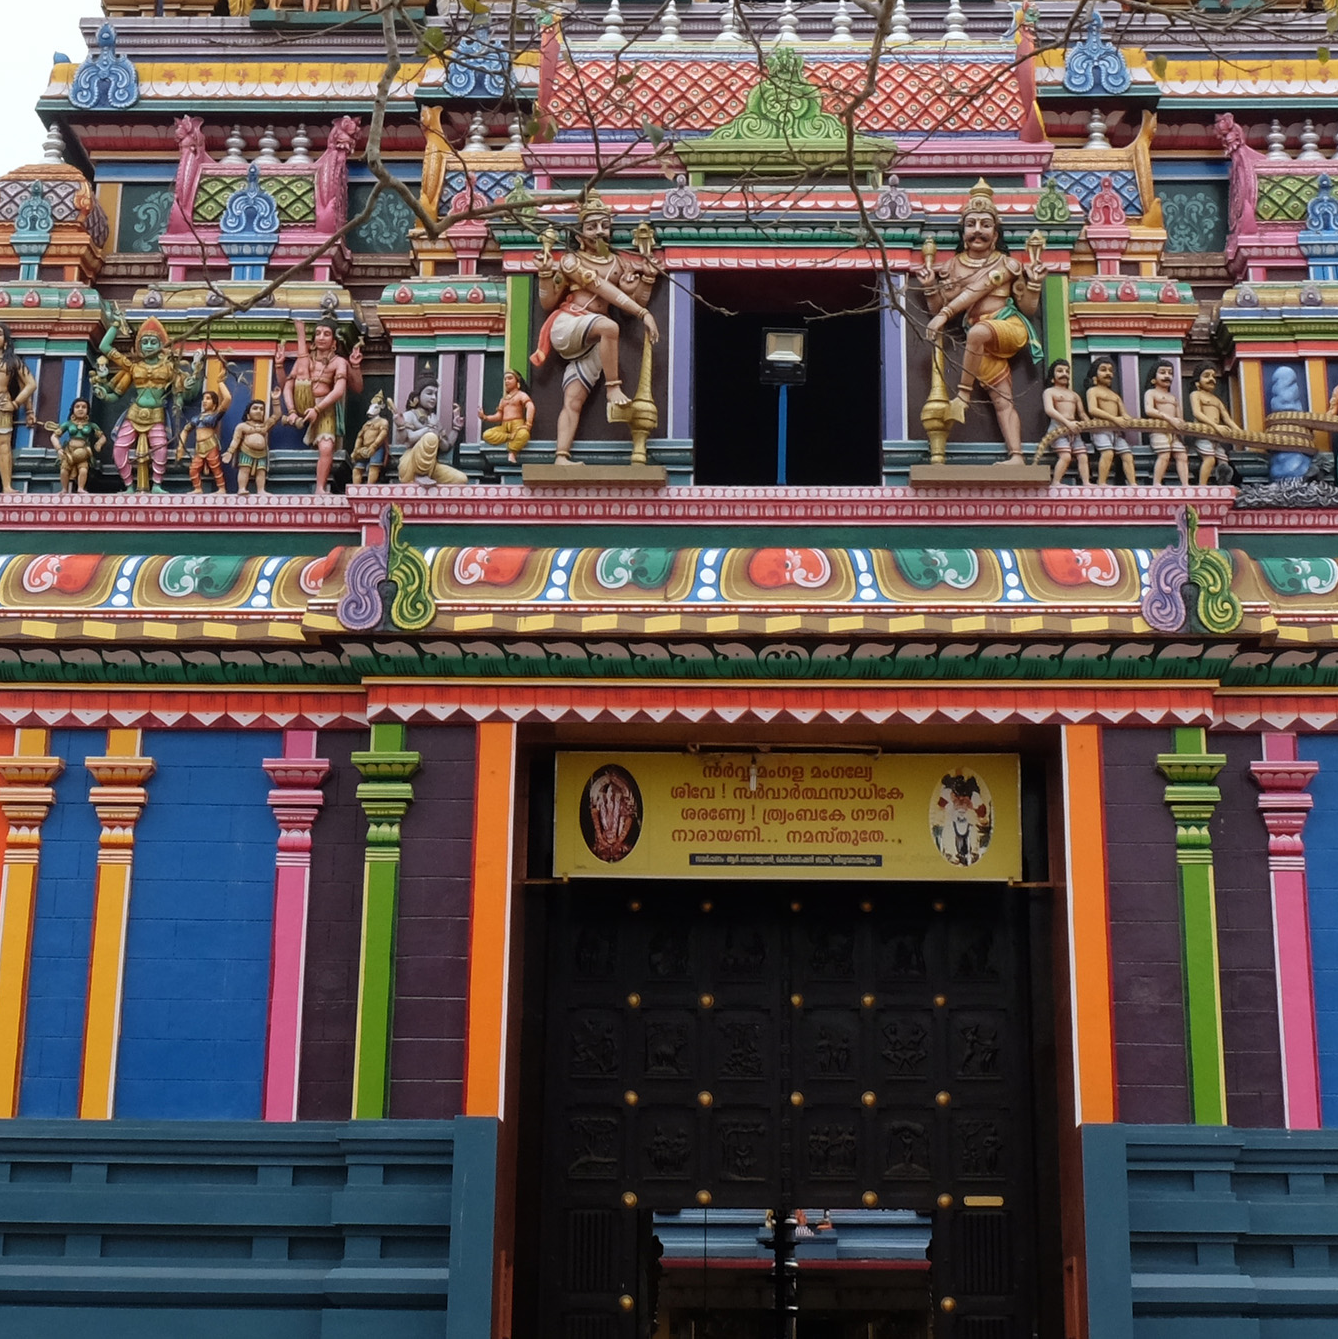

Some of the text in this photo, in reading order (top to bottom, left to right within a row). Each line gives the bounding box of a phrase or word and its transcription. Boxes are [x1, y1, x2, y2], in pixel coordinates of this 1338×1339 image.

[756, 765, 805, 782] മംഗള
[811, 765, 873, 782] മംഗല്യേ
[670, 783, 715, 799] ശിവേ
[680, 806, 746, 825] ശരണ്യേ
[850, 805, 894, 821] ഗൗരി
